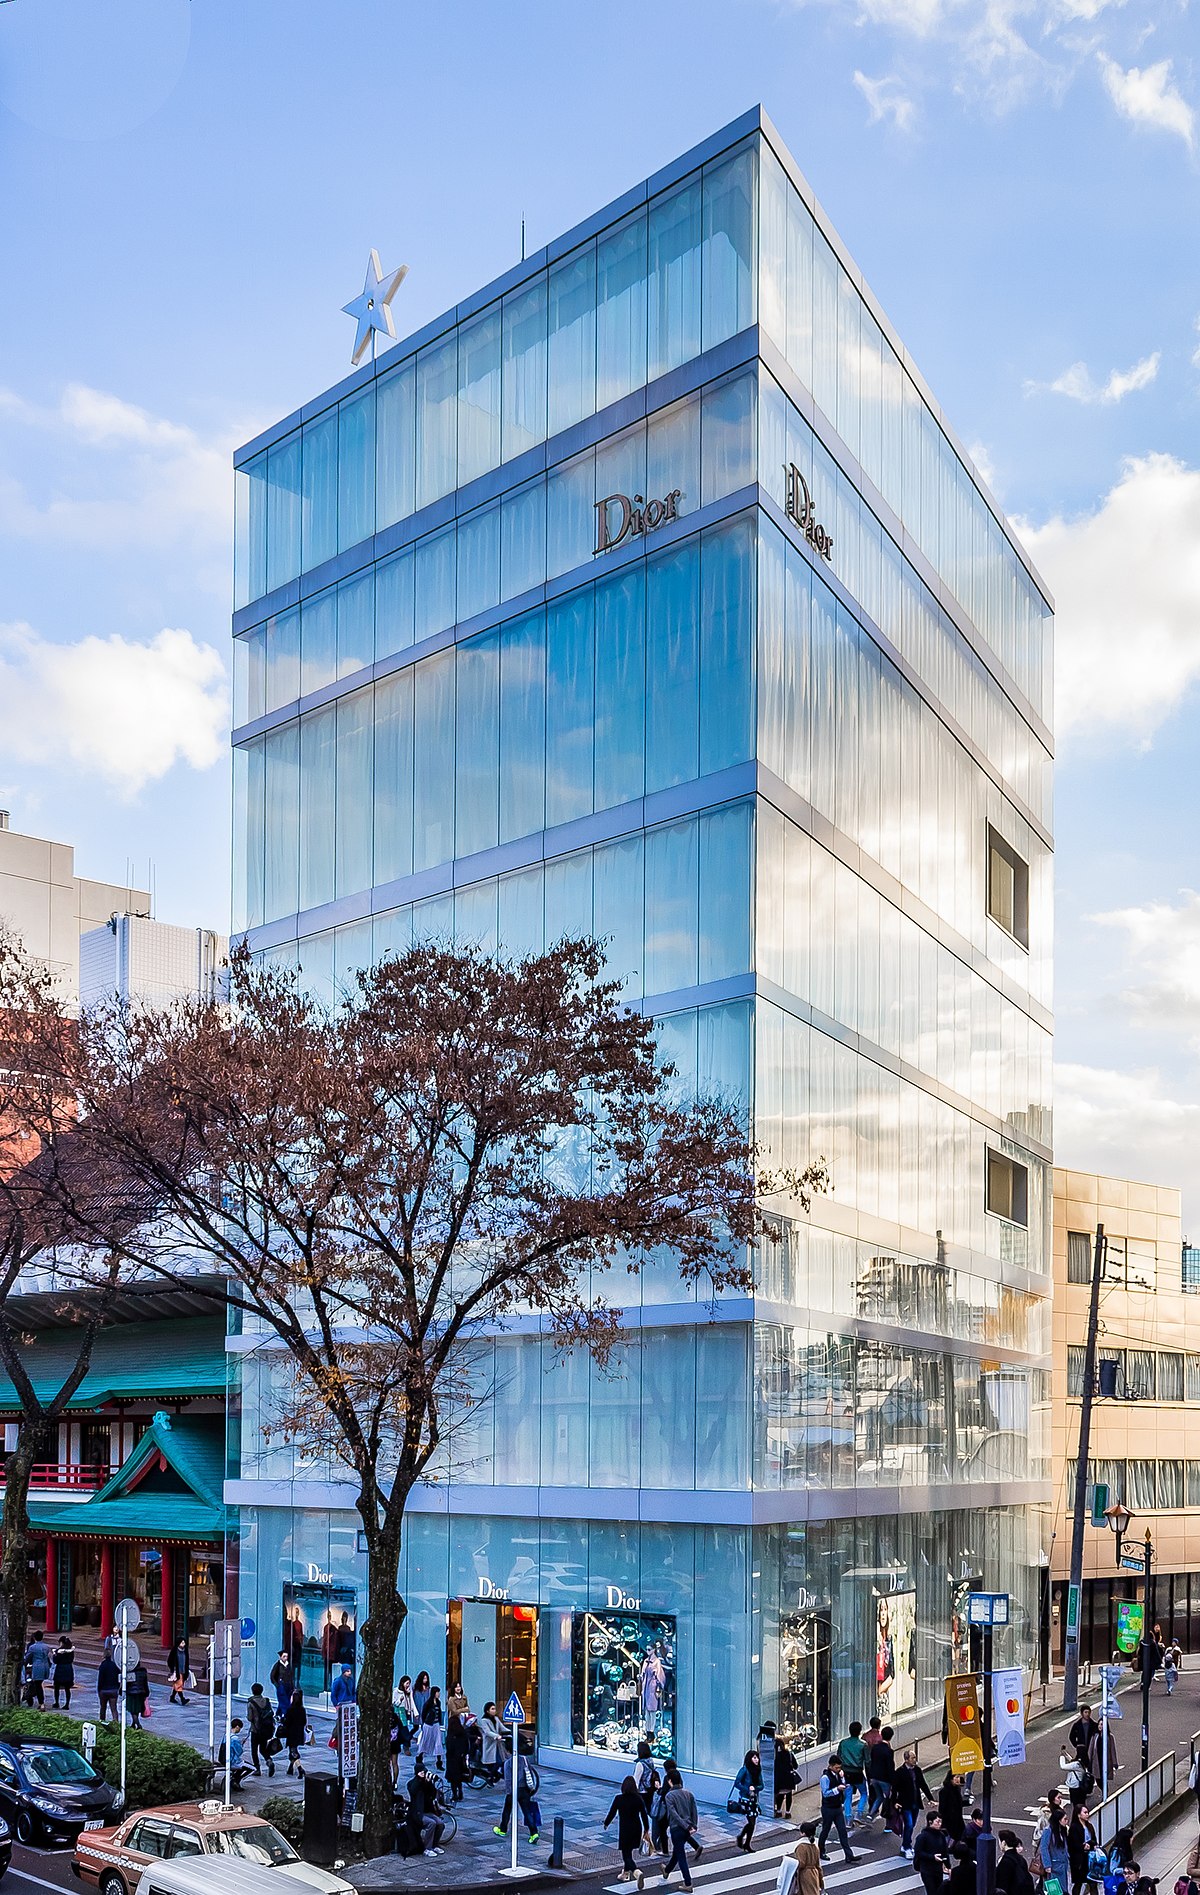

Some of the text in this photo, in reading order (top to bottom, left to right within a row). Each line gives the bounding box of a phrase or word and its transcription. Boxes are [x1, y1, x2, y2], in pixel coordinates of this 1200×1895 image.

[592, 488, 682, 555] Dior
[782, 462, 835, 562] Dior
[307, 1562, 334, 1584] Dior
[961, 1560, 973, 1578] Dior
[478, 1576, 510, 1600] Dior
[606, 1585, 642, 1611] Dior
[797, 1587, 818, 1609] Dior
